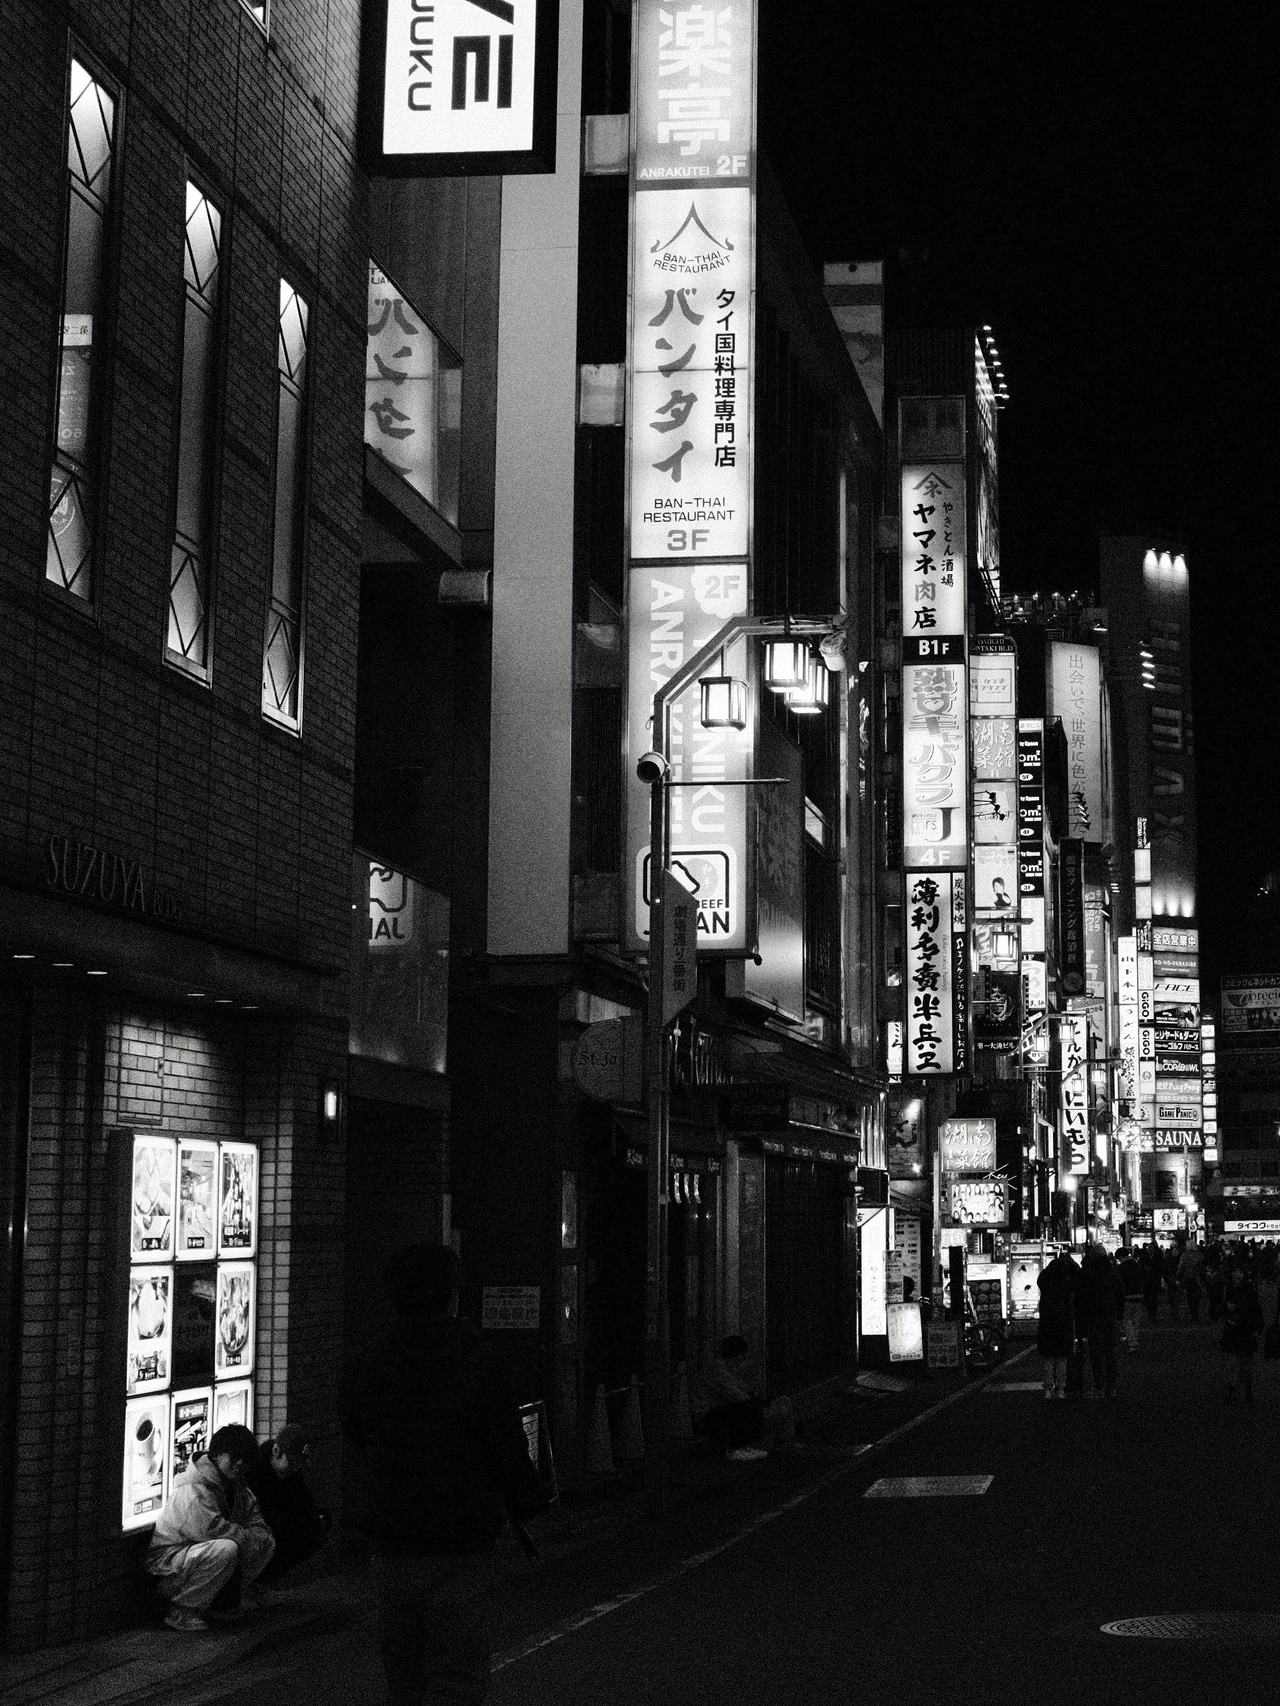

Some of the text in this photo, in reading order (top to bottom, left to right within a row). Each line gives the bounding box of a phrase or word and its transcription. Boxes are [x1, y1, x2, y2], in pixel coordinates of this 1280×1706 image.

[640, 155, 747, 178] ANRAKUTEI 2F
[653, 255, 731, 274] RESTAURANT
[663, 250, 721, 264] BAN-THAI
[648, 288, 705, 483] バンタイ
[714, 289, 736, 467] タイ国料理専門店
[654, 497, 725, 509] BAN-THAI
[643, 510, 735, 522] RESTAURANT
[667, 529, 710, 551] 3F
[941, 502, 954, 588] やきとん酒場
[911, 503, 937, 630] ヤマネ肉店
[704, 575, 740, 599] 2F
[918, 639, 950, 656] B1F
[974, 721, 1015, 745] 湖南
[911, 819, 938, 831] mrs
[925, 806, 961, 842] J
[919, 849, 951, 865] 4F
[47, 835, 145, 911] SUZUYA
[953, 878, 965, 925] 炭火串焼
[1153, 933, 1196, 947] 全店営業中
[1154, 960, 1197, 968] MO-MO-PARADISE
[1154, 983, 1196, 992] FACE
[1142, 992, 1150, 1018] GiGO
[1142, 1030, 1151, 1055] GiGO
[1168, 1042, 1183, 1050] ゴルフ
[1160, 1107, 1192, 1117] GAME PANIC
[945, 1121, 992, 1146] 湖南
[1155, 1130, 1202, 1146] SAUNA
